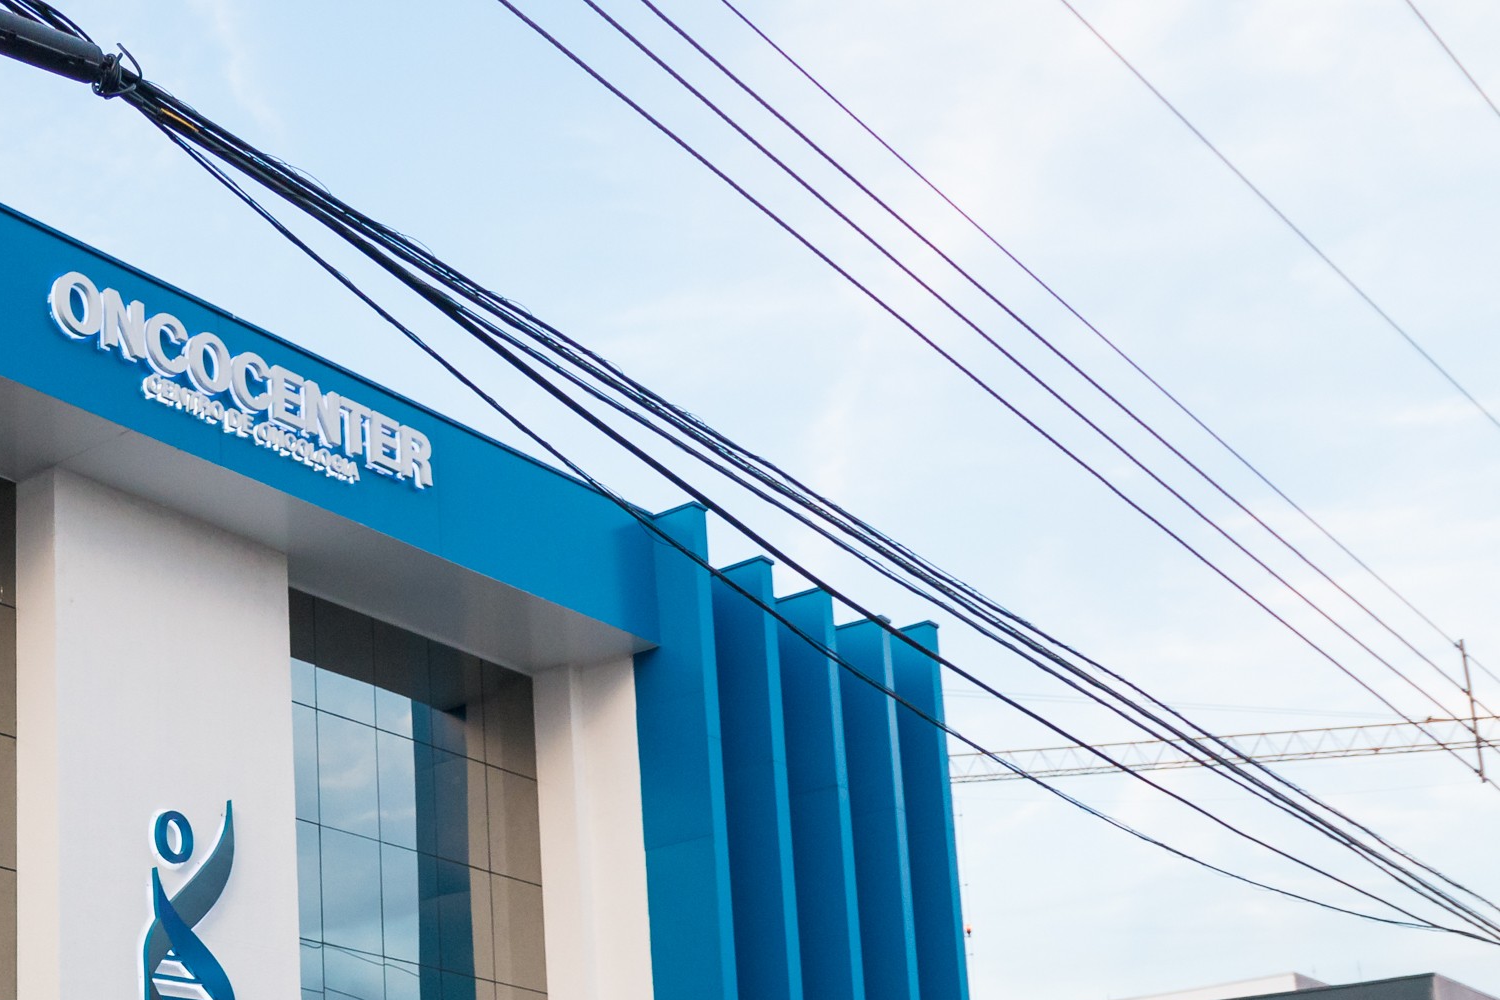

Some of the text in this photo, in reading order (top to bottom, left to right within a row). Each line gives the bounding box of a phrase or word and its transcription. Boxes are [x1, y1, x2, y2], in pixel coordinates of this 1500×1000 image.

[49, 271, 433, 489] ONCOCENTER
[142, 373, 361, 485] CENTRO DE ONCOLOGIA
